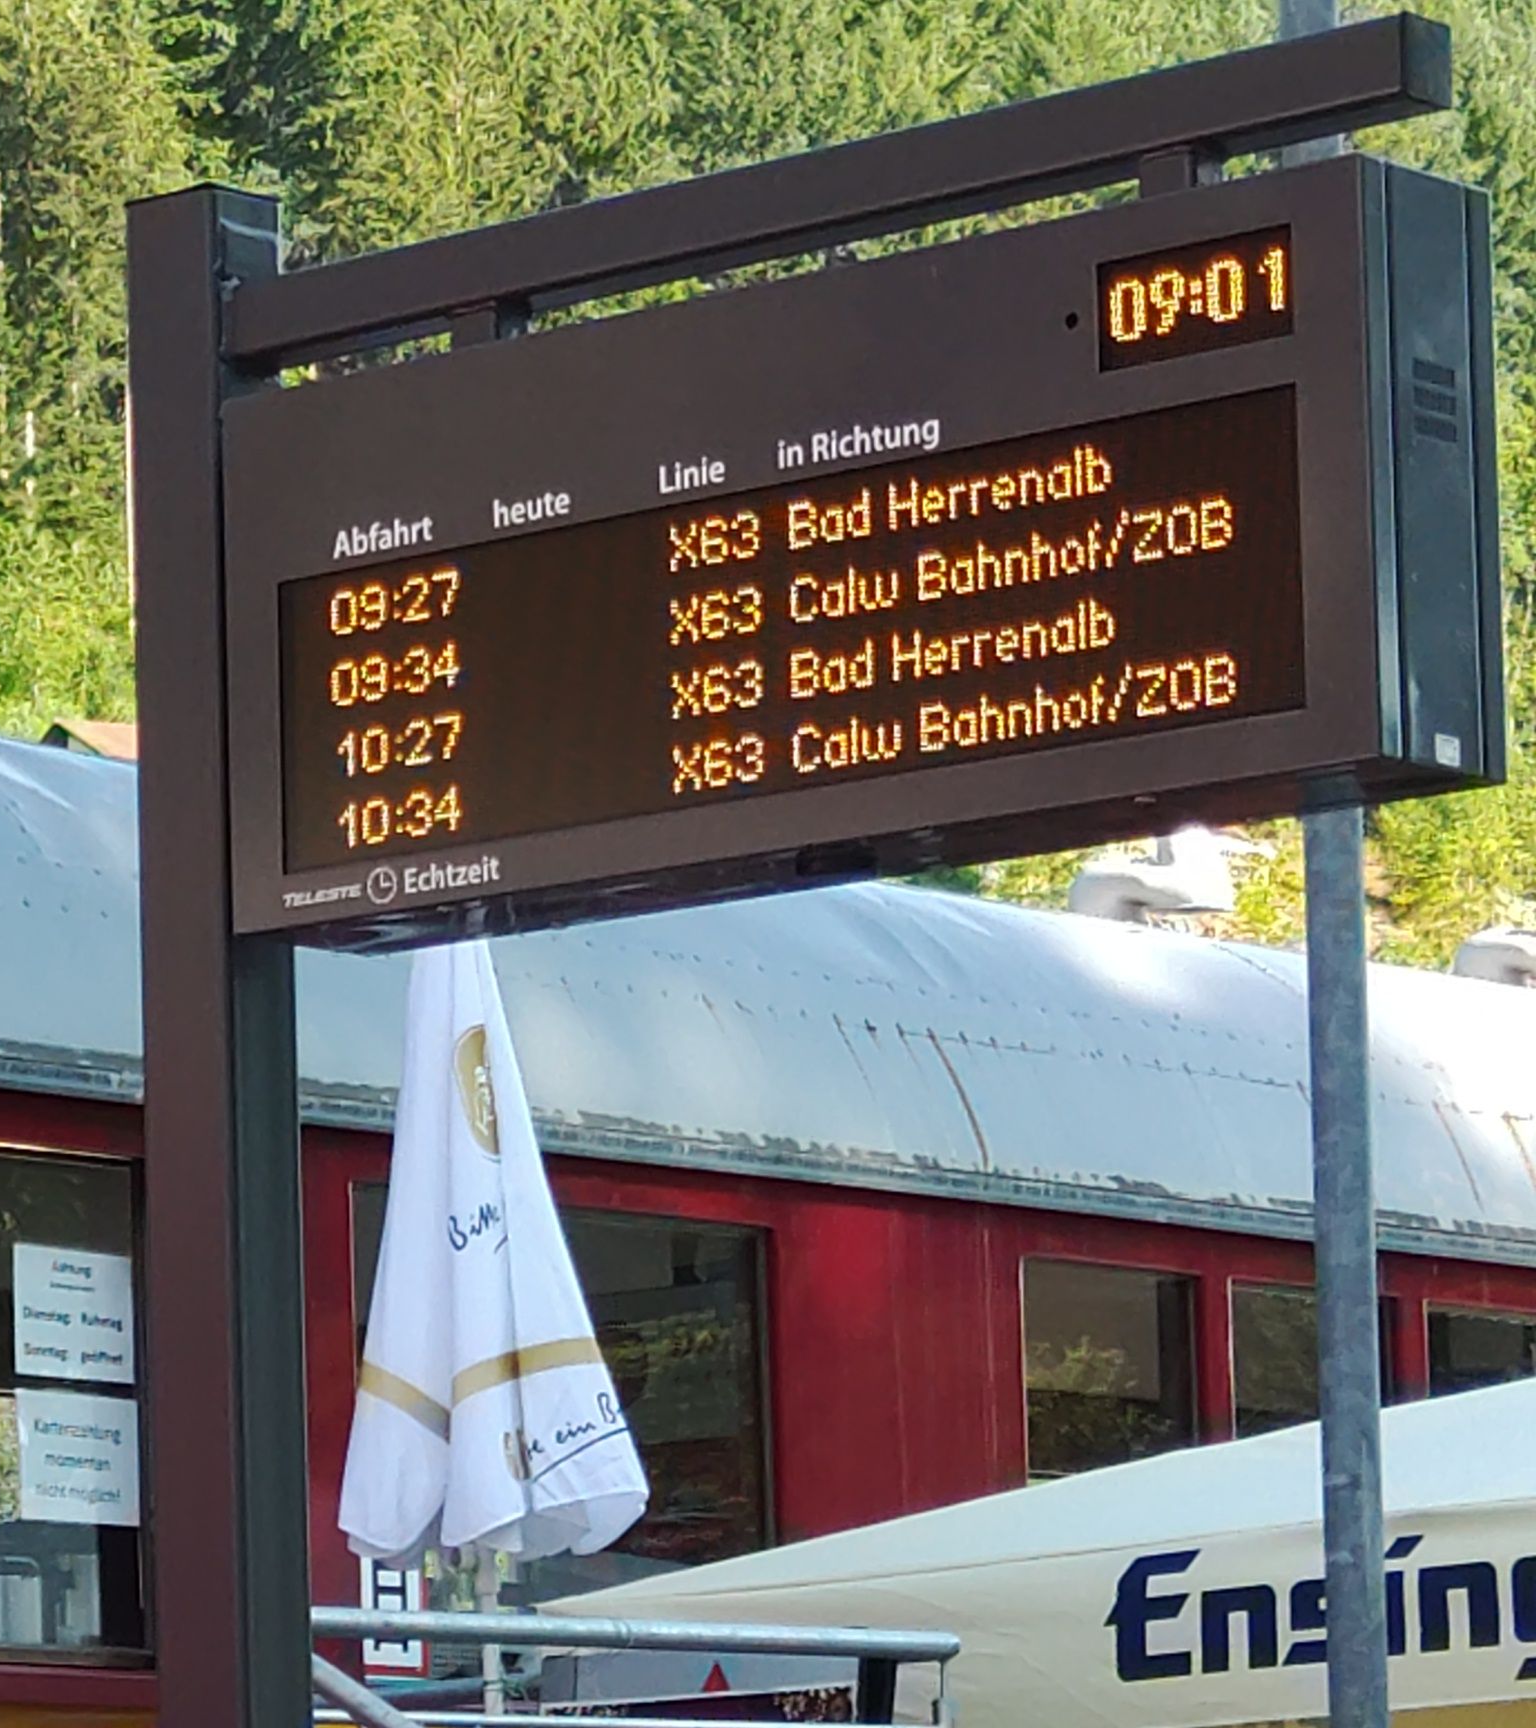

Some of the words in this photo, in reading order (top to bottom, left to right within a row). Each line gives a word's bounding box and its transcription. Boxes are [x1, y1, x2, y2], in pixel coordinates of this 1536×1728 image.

[1109, 247, 1284, 342] 09:01
[330, 566, 460, 635] 09:27
[668, 509, 761, 572] X63
[788, 486, 871, 551] Bad
[888, 443, 1111, 531] Herrenalb
[333, 516, 433, 560] Abfahrt
[492, 491, 572, 529] heute
[658, 456, 726, 494] Linie
[777, 438, 803, 470] in
[812, 418, 940, 464] Richtung
[330, 639, 460, 706] 09:34
[669, 585, 762, 646] X63
[790, 564, 899, 623] Calw
[916, 494, 1233, 602] Bahnhof/ZOB
[338, 710, 463, 777] 10:27
[670, 658, 764, 719] X63
[790, 636, 873, 699] Bad
[891, 598, 1116, 682] Herrenalb
[338, 783, 463, 848] 10:34
[672, 732, 765, 794] X63
[792, 715, 901, 773] Calw
[920, 651, 1236, 753] Bahnhof/ZOB
[282, 883, 362, 908] TELESTE
[404, 856, 500, 894] Echtzeit
[1103, 1534, 1536, 1683] Ensin
